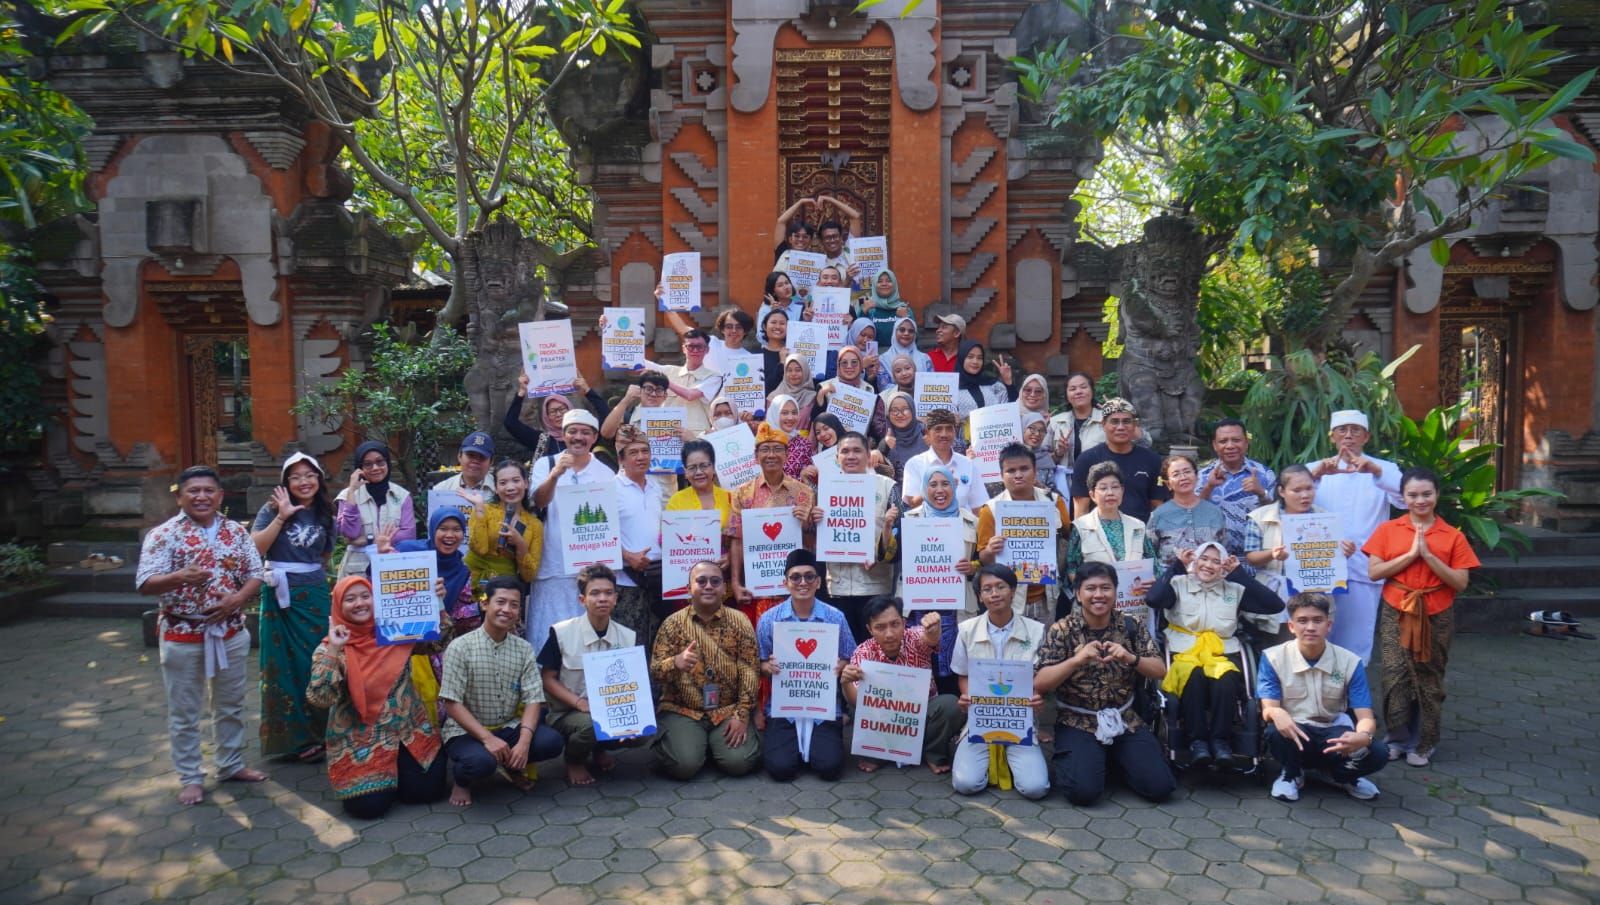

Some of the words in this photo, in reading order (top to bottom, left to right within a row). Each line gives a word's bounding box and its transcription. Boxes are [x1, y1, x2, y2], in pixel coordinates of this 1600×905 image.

[604, 345, 643, 353] BERSAMA
[613, 353, 634, 361] BUMI
[725, 385, 763, 393] BERJALAN
[924, 384, 949, 393] IKLIM
[920, 394, 952, 403] RUSAK
[979, 429, 1012, 440] LESTARI
[717, 461, 737, 470] CLEAN
[722, 466, 741, 476] CLEAN
[830, 496, 864, 507] BUMI
[830, 508, 864, 517] adalah
[827, 518, 866, 530] MASJID
[1002, 517, 1049, 526] DIFABEL
[572, 525, 609, 534] MENJAGA
[1002, 529, 1049, 538] BERAKSI
[577, 533, 605, 542] HUTAN
[833, 529, 861, 542] kita
[569, 543, 600, 551] Menjaga
[749, 544, 773, 552] ENERGI
[773, 542, 796, 551] BERSIH
[920, 544, 945, 552] BUMI
[1008, 541, 1044, 549] UNTUK
[1291, 541, 1338, 550] HARMONI
[670, 548, 715, 556] INDONESIA
[759, 551, 788, 559] UNTUK
[1013, 551, 1040, 560] BUMI
[1295, 550, 1335, 560] LINTAS
[914, 555, 952, 563] ADALAH
[1301, 559, 1331, 569] IMAN
[752, 561, 771, 569] HATI
[917, 565, 950, 573] RUMAH
[380, 568, 430, 581] ENERGI
[1299, 569, 1336, 578] UNTUK
[942, 576, 962, 584] KITA
[1303, 577, 1331, 586] BUMI
[381, 581, 430, 595] BERSIH
[382, 597, 405, 607] HATI
[404, 595, 431, 606] YANG
[382, 605, 433, 619] BERSIH
[780, 661, 804, 670] ENERGI
[805, 662, 831, 671] BERSIH
[788, 671, 822, 679] UNTUK
[599, 682, 639, 696] LINTAS
[780, 679, 802, 689] HATI
[803, 681, 829, 690] YANG
[789, 689, 820, 699] BERSIH
[865, 685, 893, 698] Jaga
[605, 693, 635, 706] IMAN
[971, 696, 1005, 706] FAITH
[1007, 697, 1031, 706] FOR
[863, 696, 921, 714] IMANMU
[607, 704, 636, 717] SATU
[975, 706, 1027, 717] CLIMATE
[609, 715, 639, 728] BUMI
[891, 713, 919, 726] Jaga
[976, 718, 1025, 730] JUSTICE
[860, 719, 918, 737] BUMIMU
